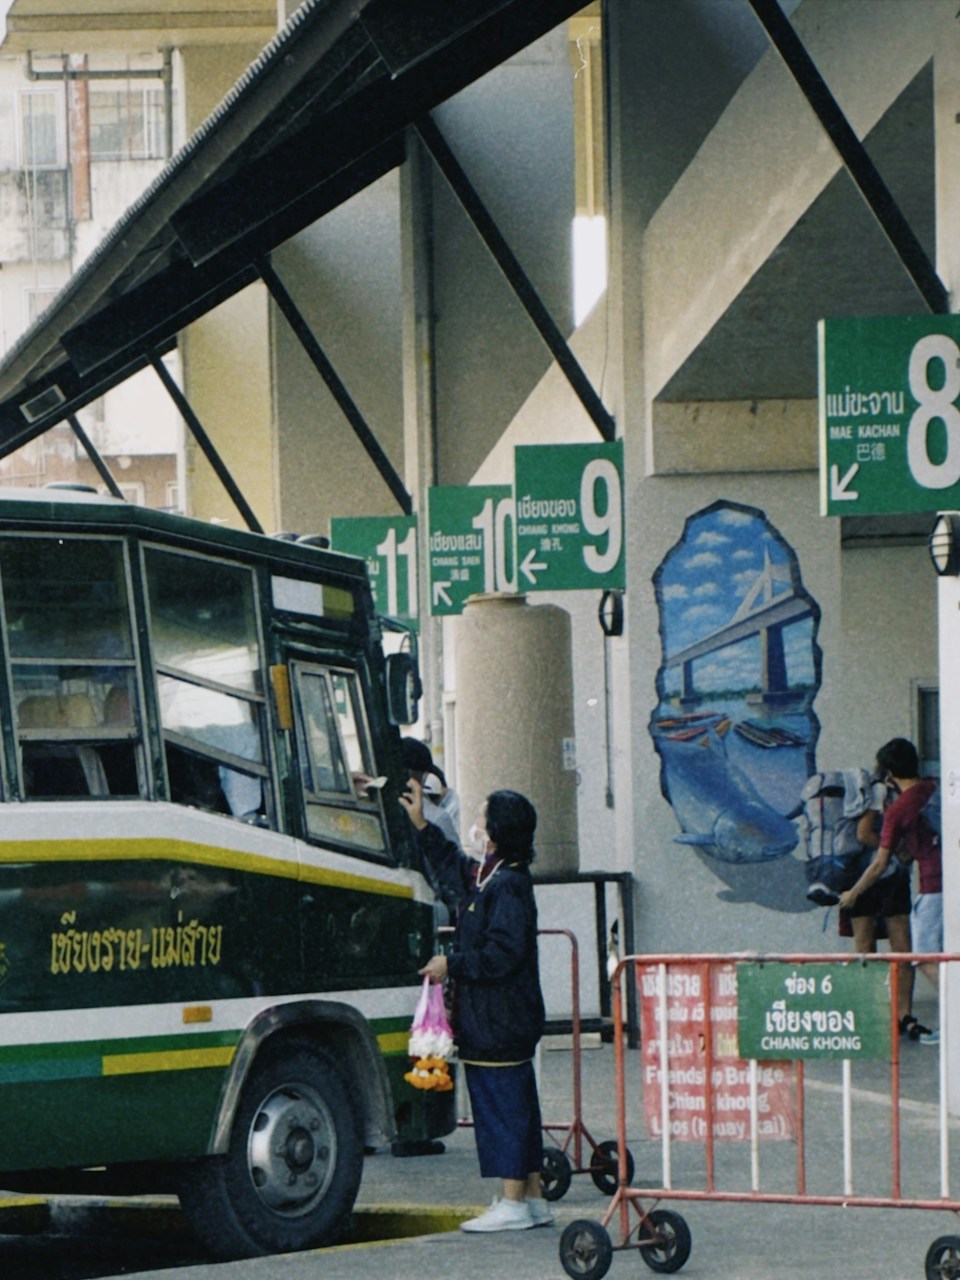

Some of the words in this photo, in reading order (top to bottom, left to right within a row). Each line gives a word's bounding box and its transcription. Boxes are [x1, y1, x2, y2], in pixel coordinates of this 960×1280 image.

[826, 385, 904, 417] แม่ขะจาน
[906, 333, 960, 489] 8
[830, 425, 853, 439] MAE
[858, 424, 901, 438] KACHAN
[517, 496, 576, 519] เชียงของ
[580, 458, 622, 574] 9
[472, 498, 515, 593] 10
[518, 523, 548, 536] CHIANG
[377, 527, 417, 619] 11
[50, 910, 223, 974] เชียงราย-แม่สาย
[785, 972, 816, 995] ช่อง
[821, 975, 833, 995] 6
[765, 1000, 856, 1033] เชียงของ
[761, 1036, 810, 1051] CHIANG
[813, 1036, 861, 1051] KHONG
[650, 1116, 689, 1135] Los
